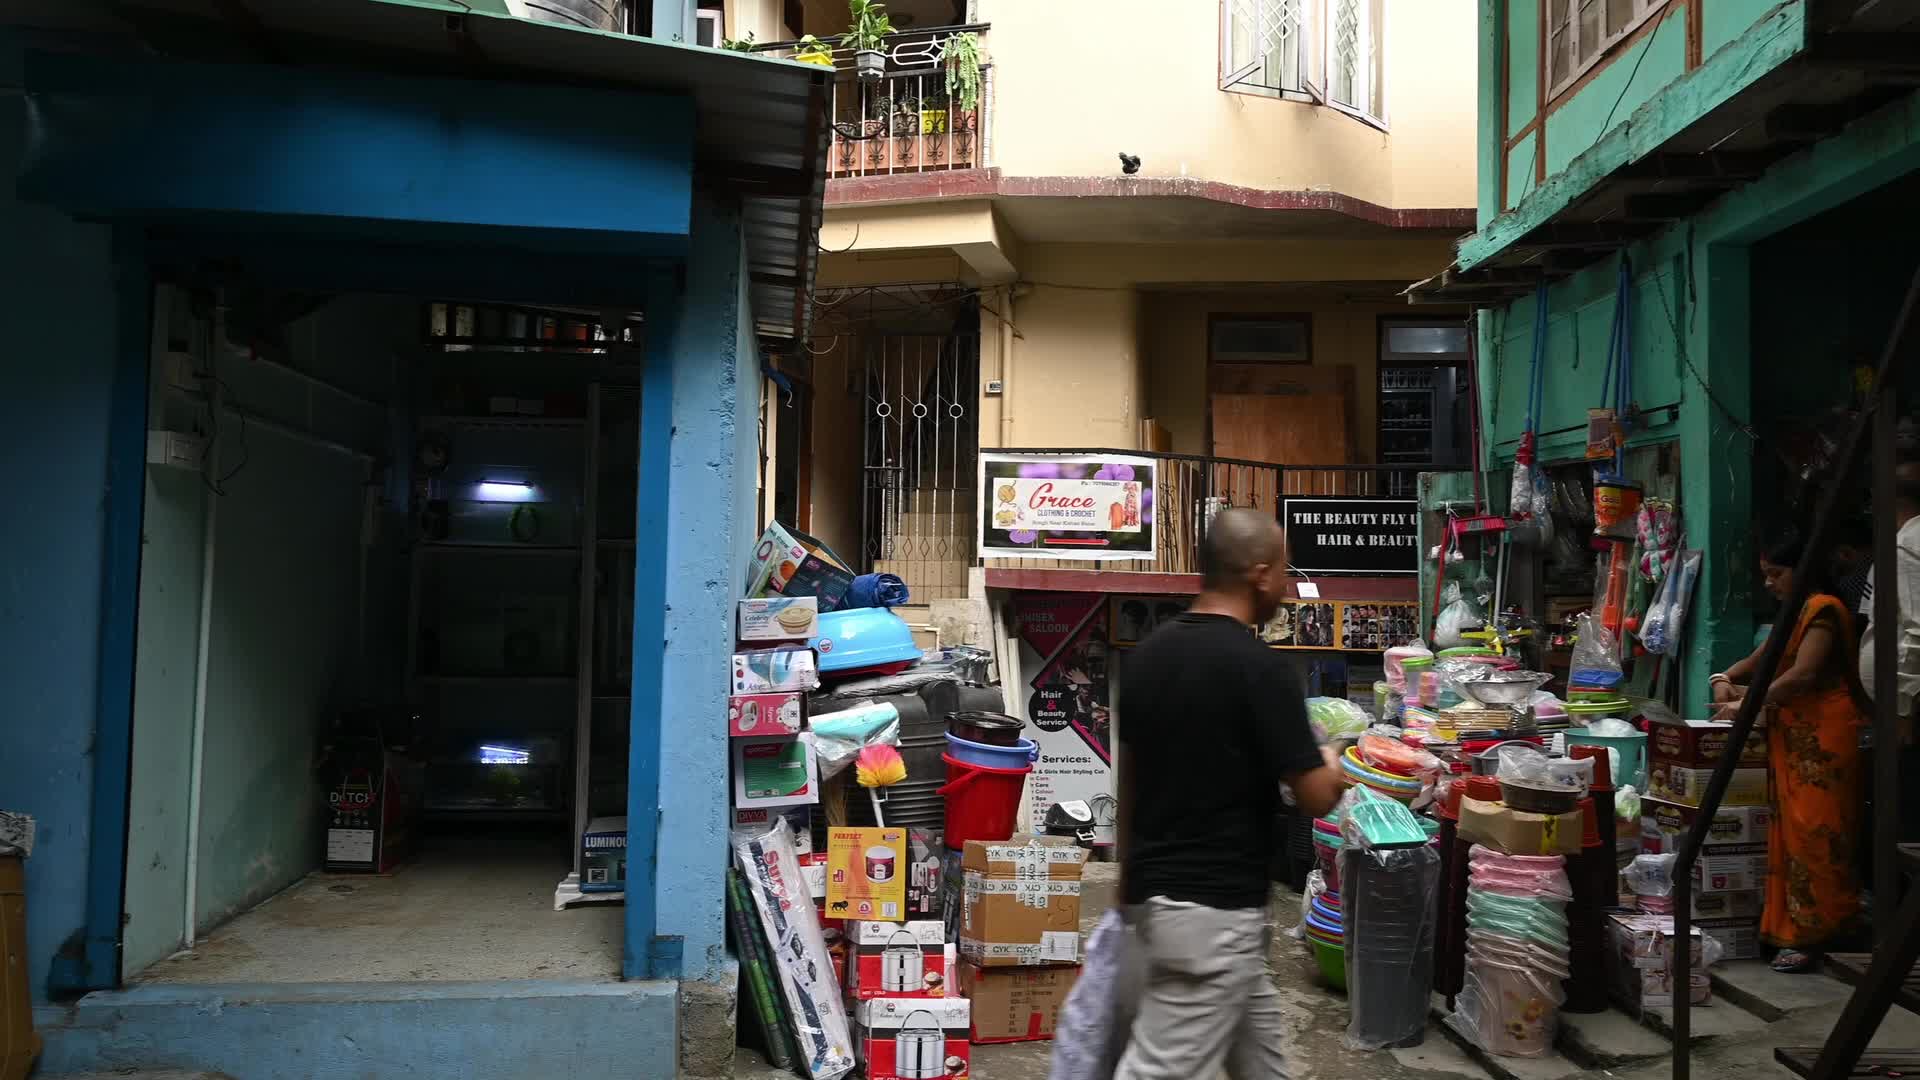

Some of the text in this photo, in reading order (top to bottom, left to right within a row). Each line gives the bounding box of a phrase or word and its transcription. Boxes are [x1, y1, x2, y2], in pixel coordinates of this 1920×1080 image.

[1029, 482, 1097, 510] Grace
[1037, 509, 1065, 517] CLOTHING
[1070, 509, 1096, 518] CROCHET
[1293, 512, 1321, 524] THE
[1325, 513, 1379, 525] BEAUTY
[1382, 513, 1407, 525] FLY
[1316, 534, 1352, 546] HAIR
[1355, 534, 1365, 546] &
[1030, 623, 1070, 633] SALOON
[1040, 690, 1063, 699] Hair
[1037, 709, 1067, 718] Beauty
[1036, 718, 1068, 726] Service
[1041, 754, 1092, 763] Services:
[763, 850, 792, 912] Surya
